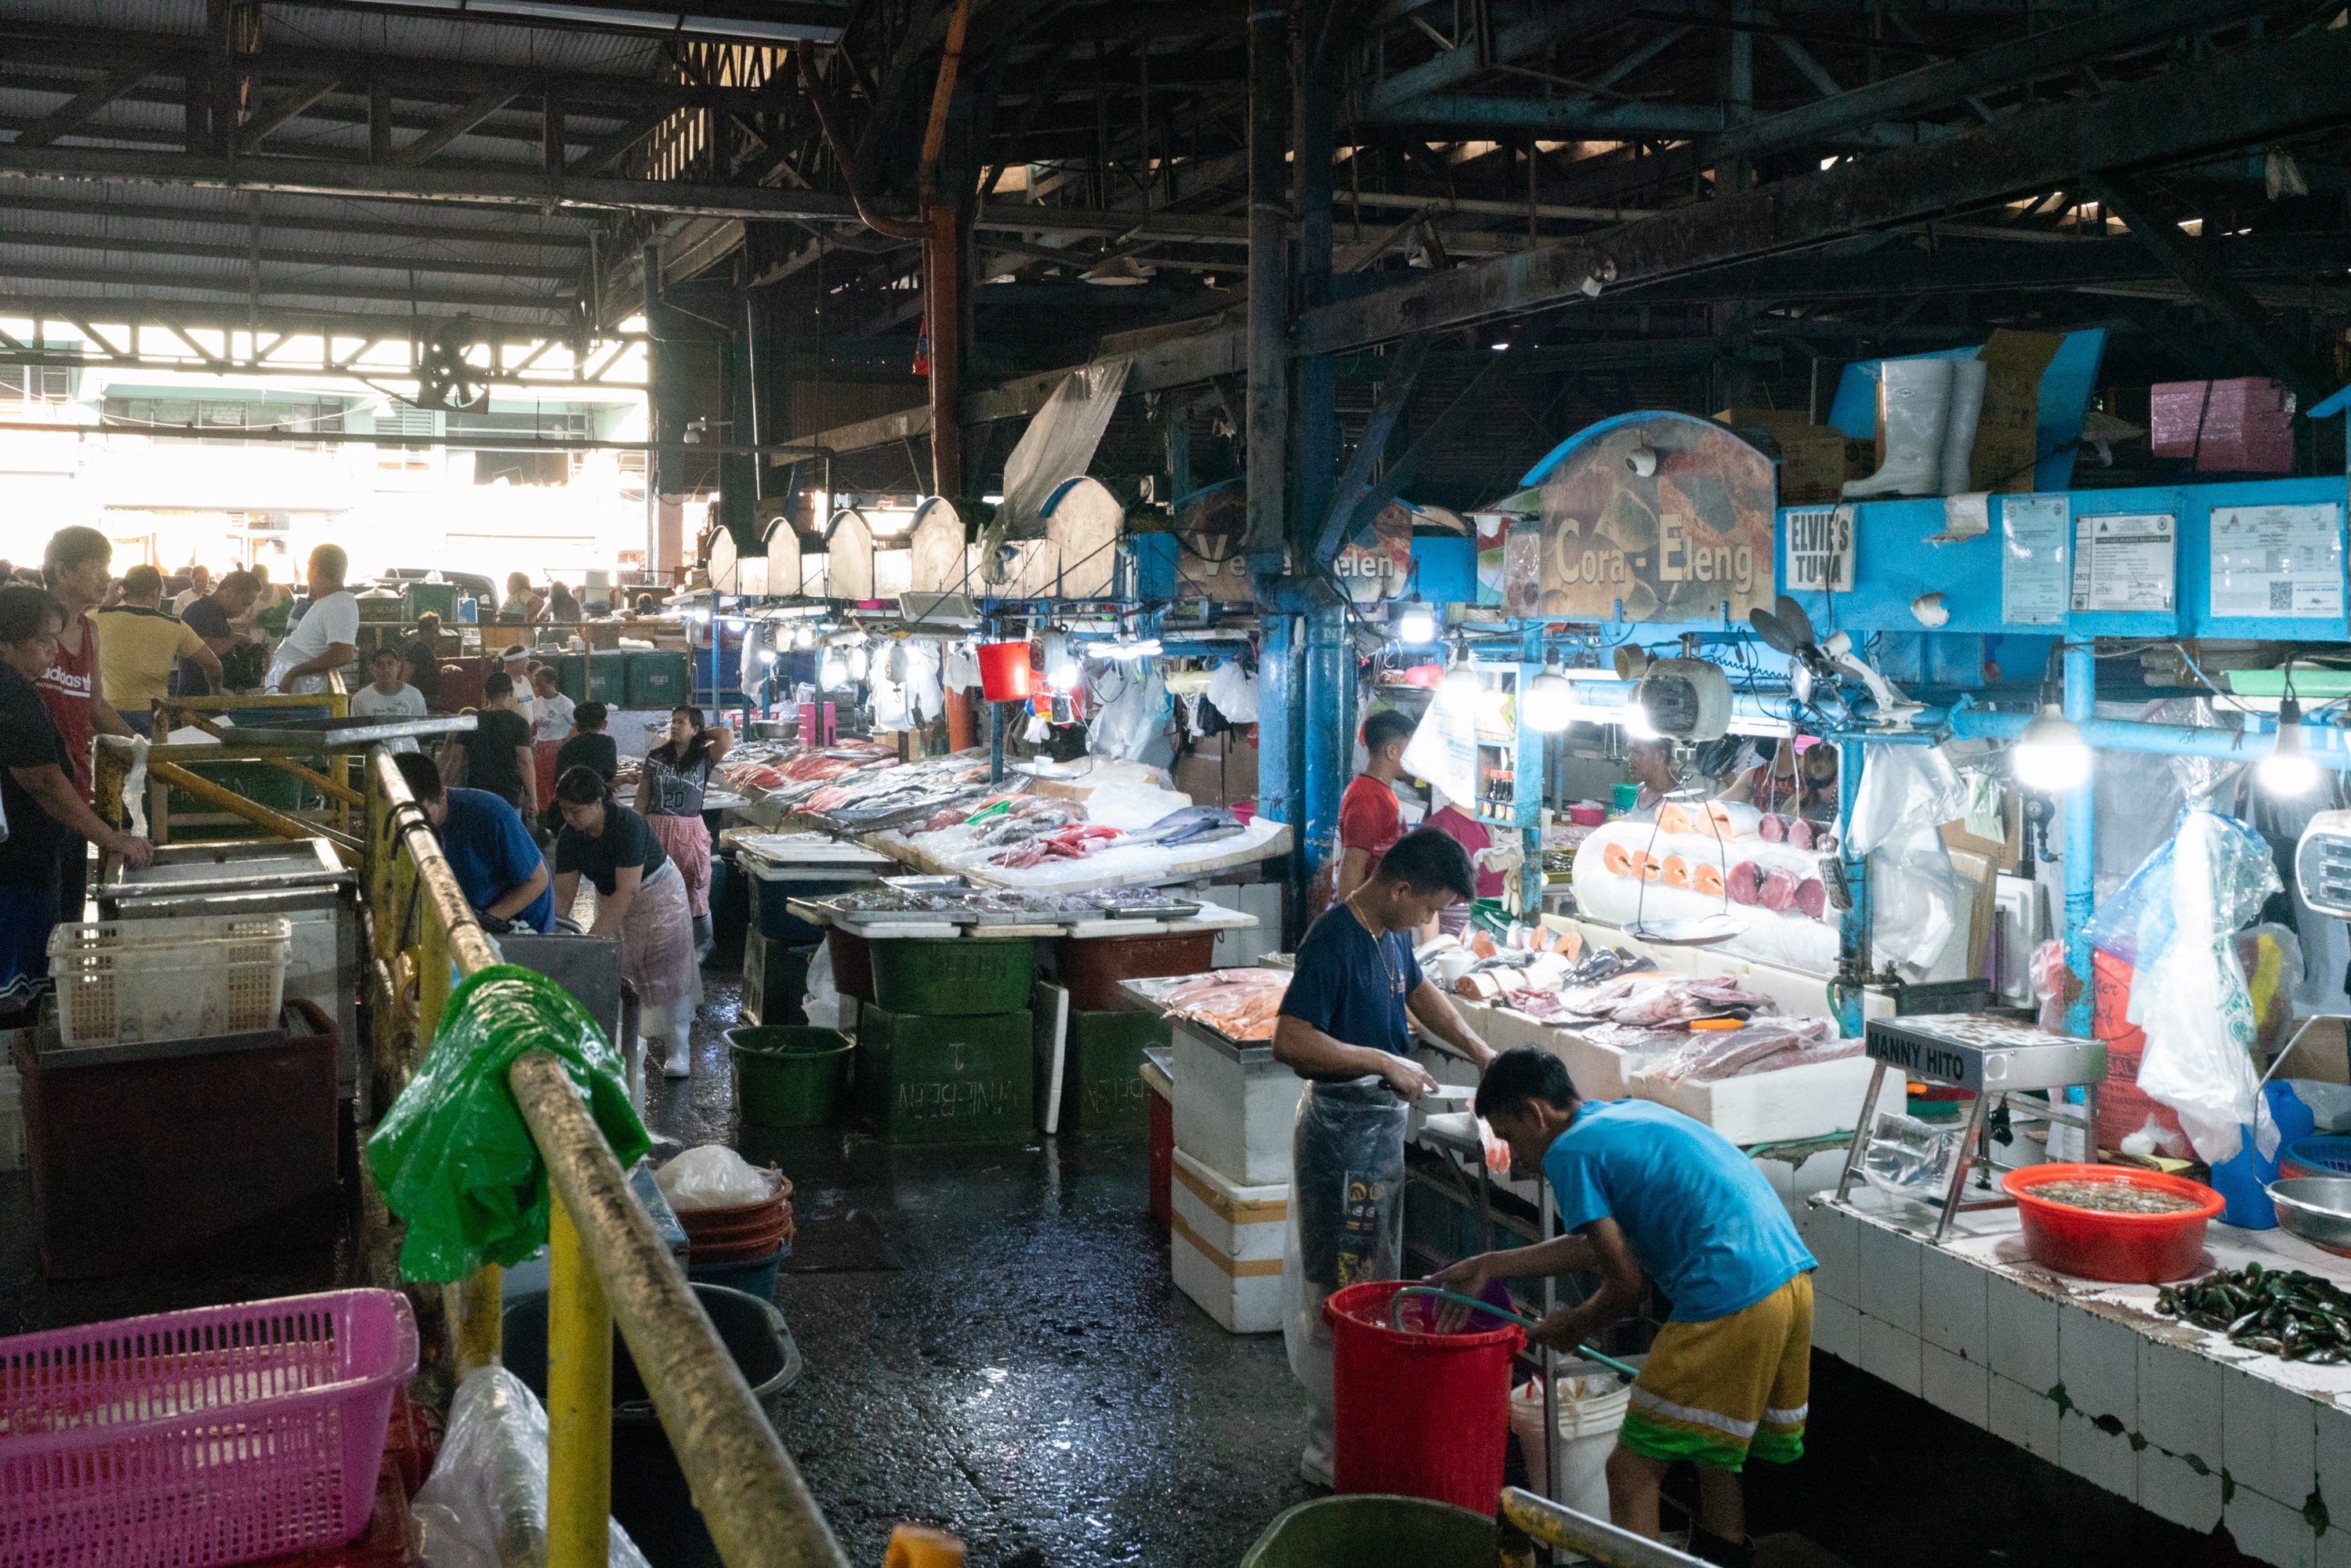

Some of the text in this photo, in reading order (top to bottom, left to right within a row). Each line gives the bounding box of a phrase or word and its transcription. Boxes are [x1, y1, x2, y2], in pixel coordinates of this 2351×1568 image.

[1791, 514, 1849, 552] ELVIE'S
[1334, 549, 1394, 578] elen
[1556, 518, 1625, 585] Cora
[1658, 513, 1753, 594] Eleng
[1795, 555, 1842, 584] TUNA
[664, 791, 684, 808] 20
[1867, 1030, 1964, 1081] MANNY HITO
